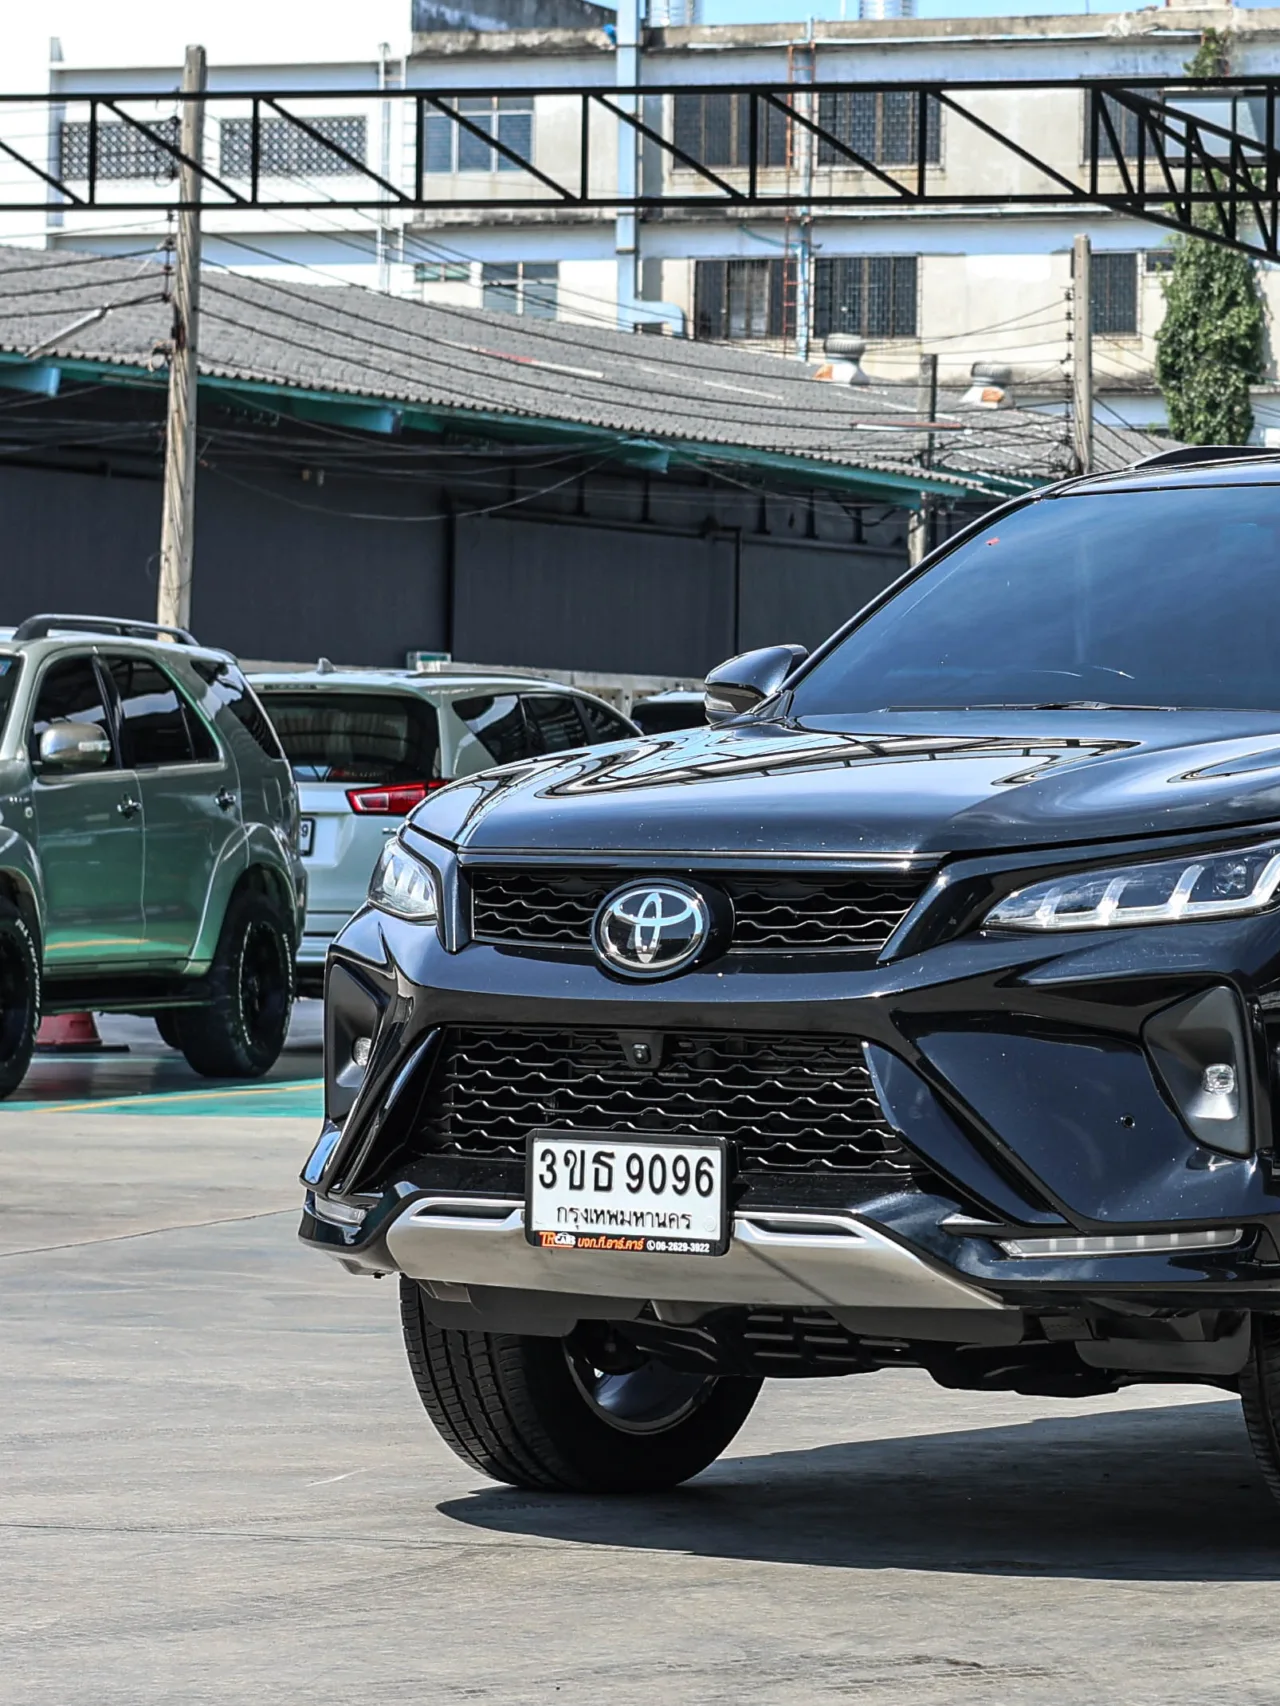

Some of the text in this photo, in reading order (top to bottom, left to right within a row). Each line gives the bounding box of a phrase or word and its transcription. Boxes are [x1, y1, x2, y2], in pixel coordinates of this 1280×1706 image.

[538, 1148, 715, 1197] 3ขธ 9096
[556, 1205, 692, 1231] กรุงเทพมหานคร
